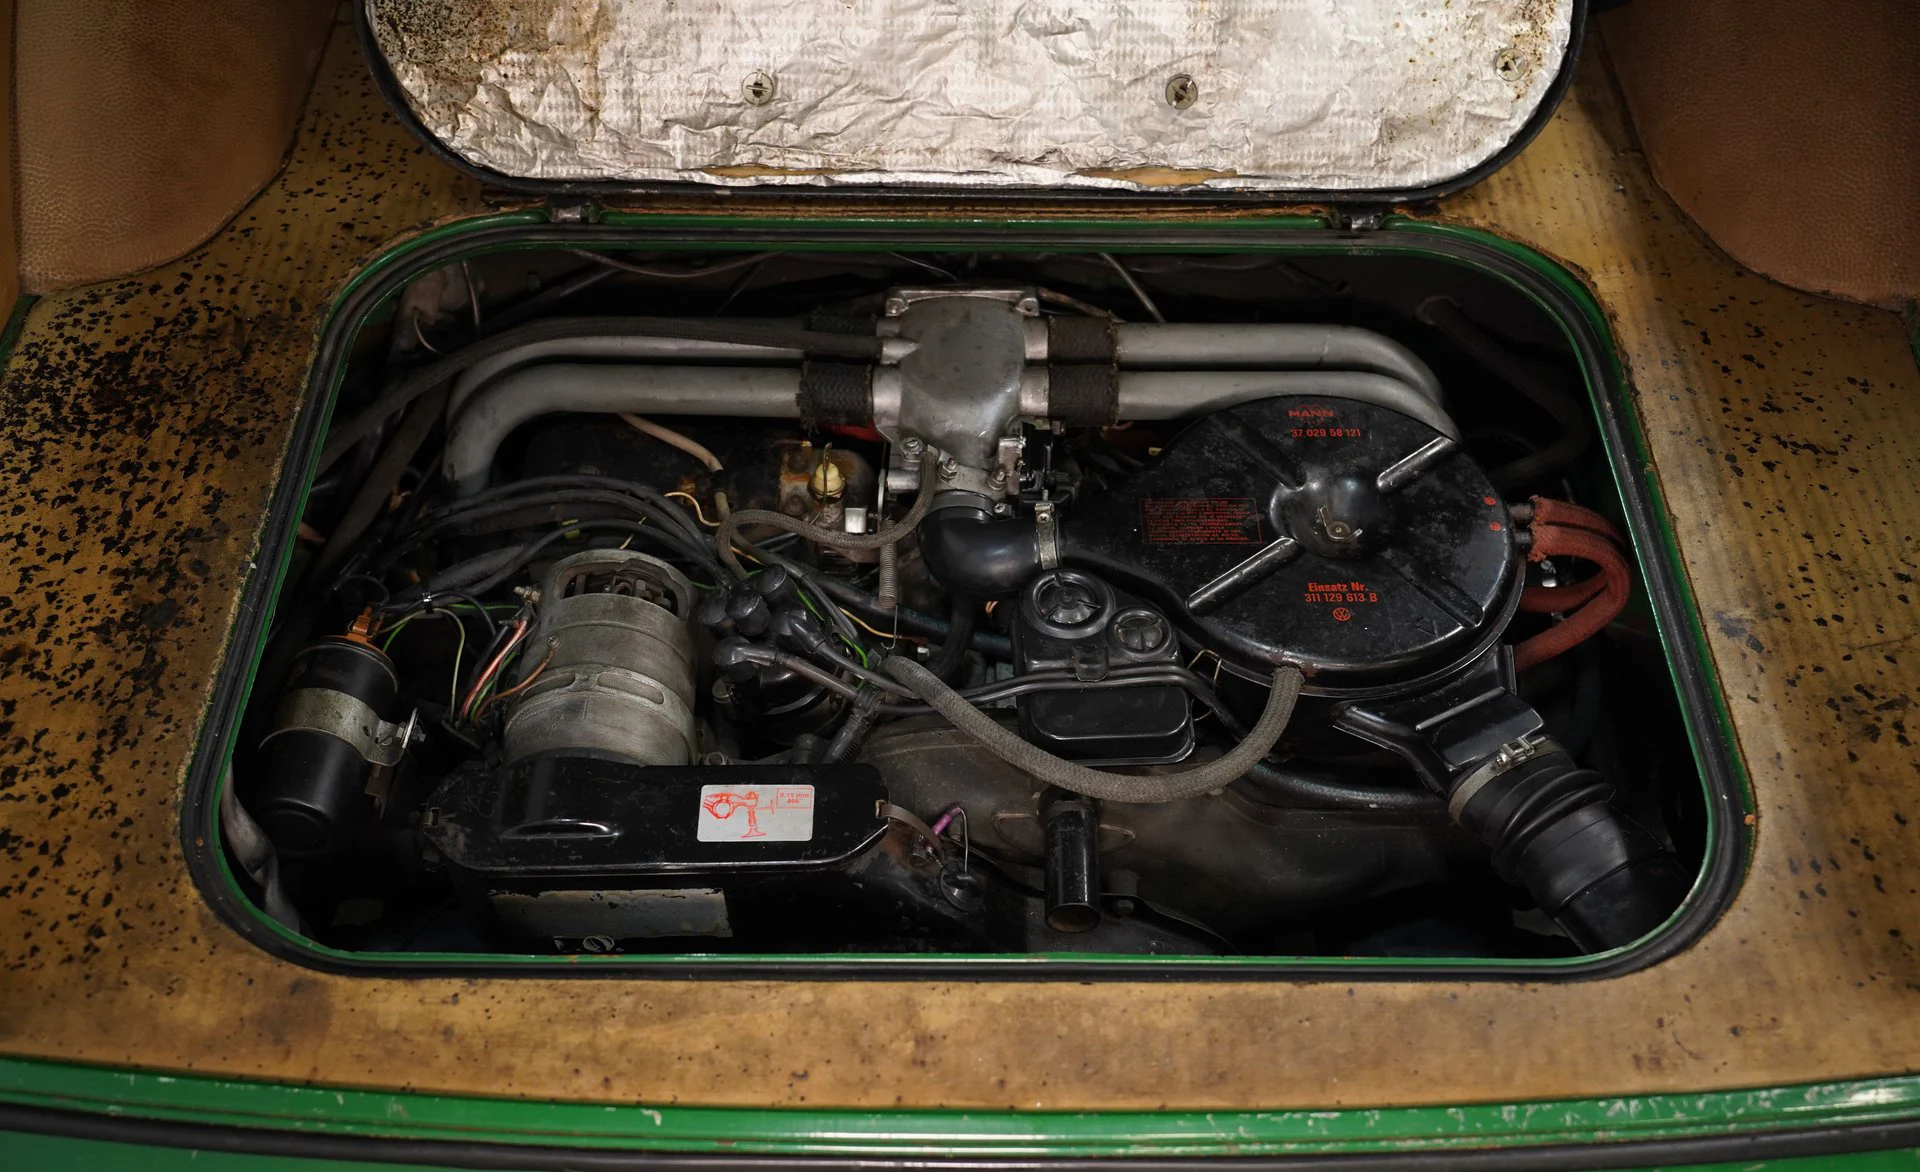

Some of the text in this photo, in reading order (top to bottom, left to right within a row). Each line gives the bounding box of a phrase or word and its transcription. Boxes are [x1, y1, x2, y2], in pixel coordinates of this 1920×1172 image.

[1288, 409, 1334, 417] MANN
[1291, 428, 1361, 437] 37 029 58 121
[1308, 582, 1368, 592] Einsatz Nr.
[1304, 593, 1378, 602] 311 129 613 B
